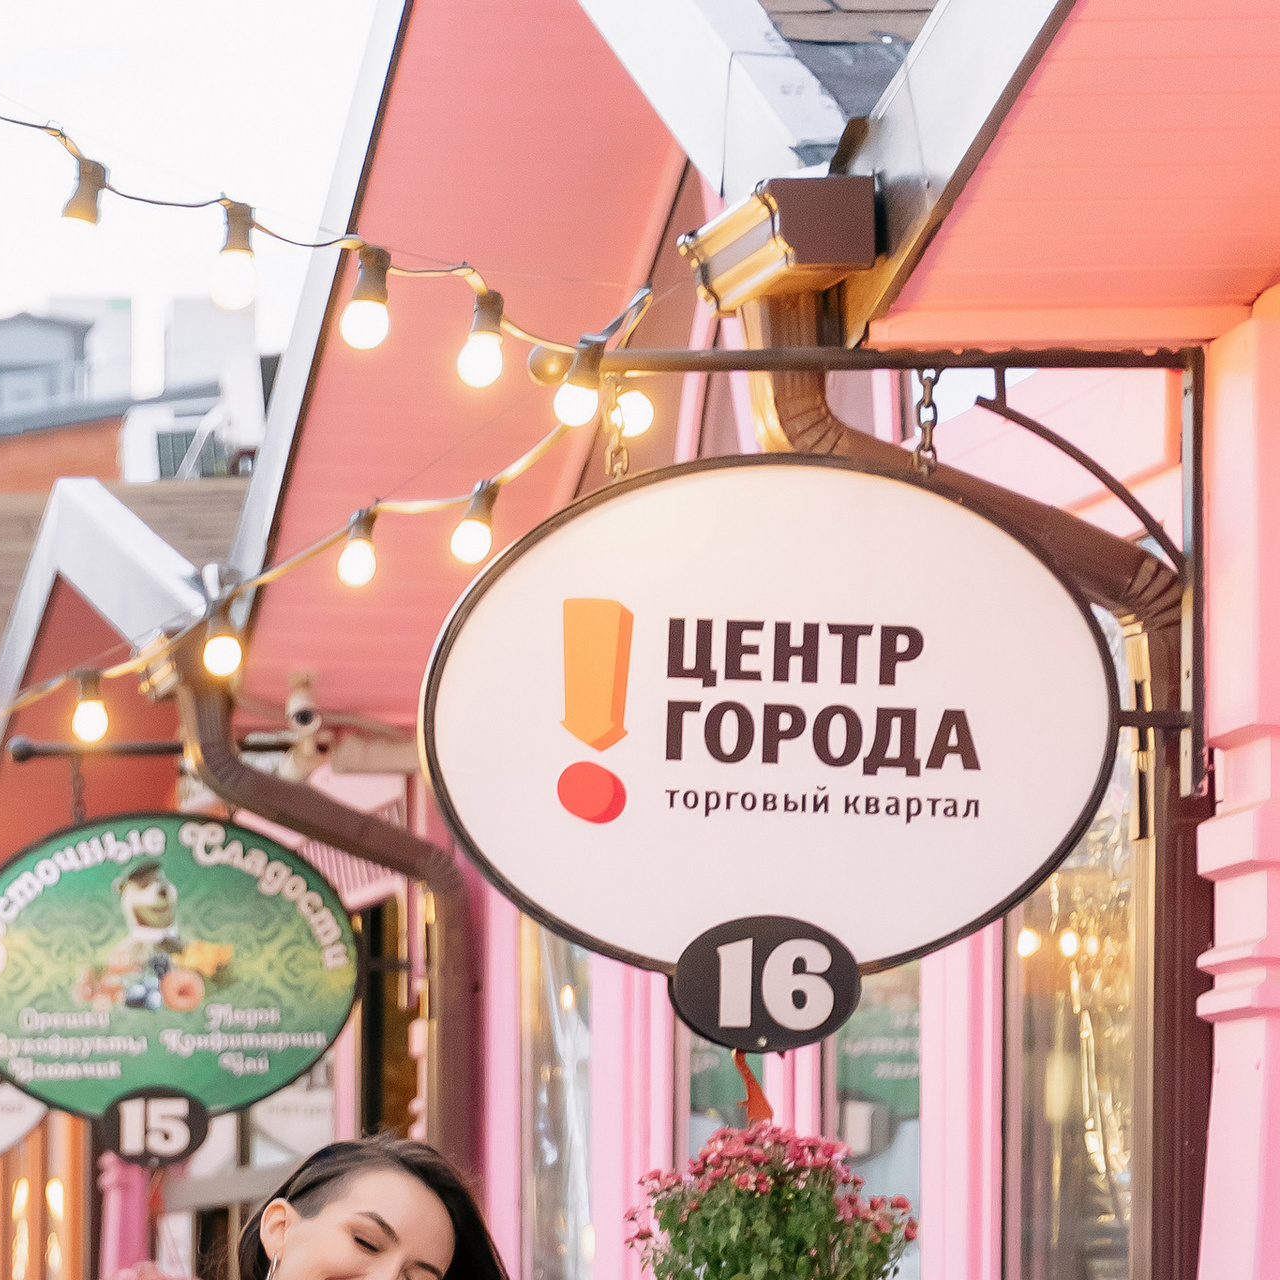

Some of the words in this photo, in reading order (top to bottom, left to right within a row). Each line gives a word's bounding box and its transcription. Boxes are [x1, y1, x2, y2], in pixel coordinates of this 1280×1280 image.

[665, 617, 925, 688] ЦЕНТР
[664, 700, 982, 777] ГОРОДА
[665, 786, 830, 817] торговый
[843, 793, 981, 822] квартал
[178, 821, 350, 971] Сладости
[716, 936, 835, 1031] 16
[119, 1097, 192, 1157] 15
